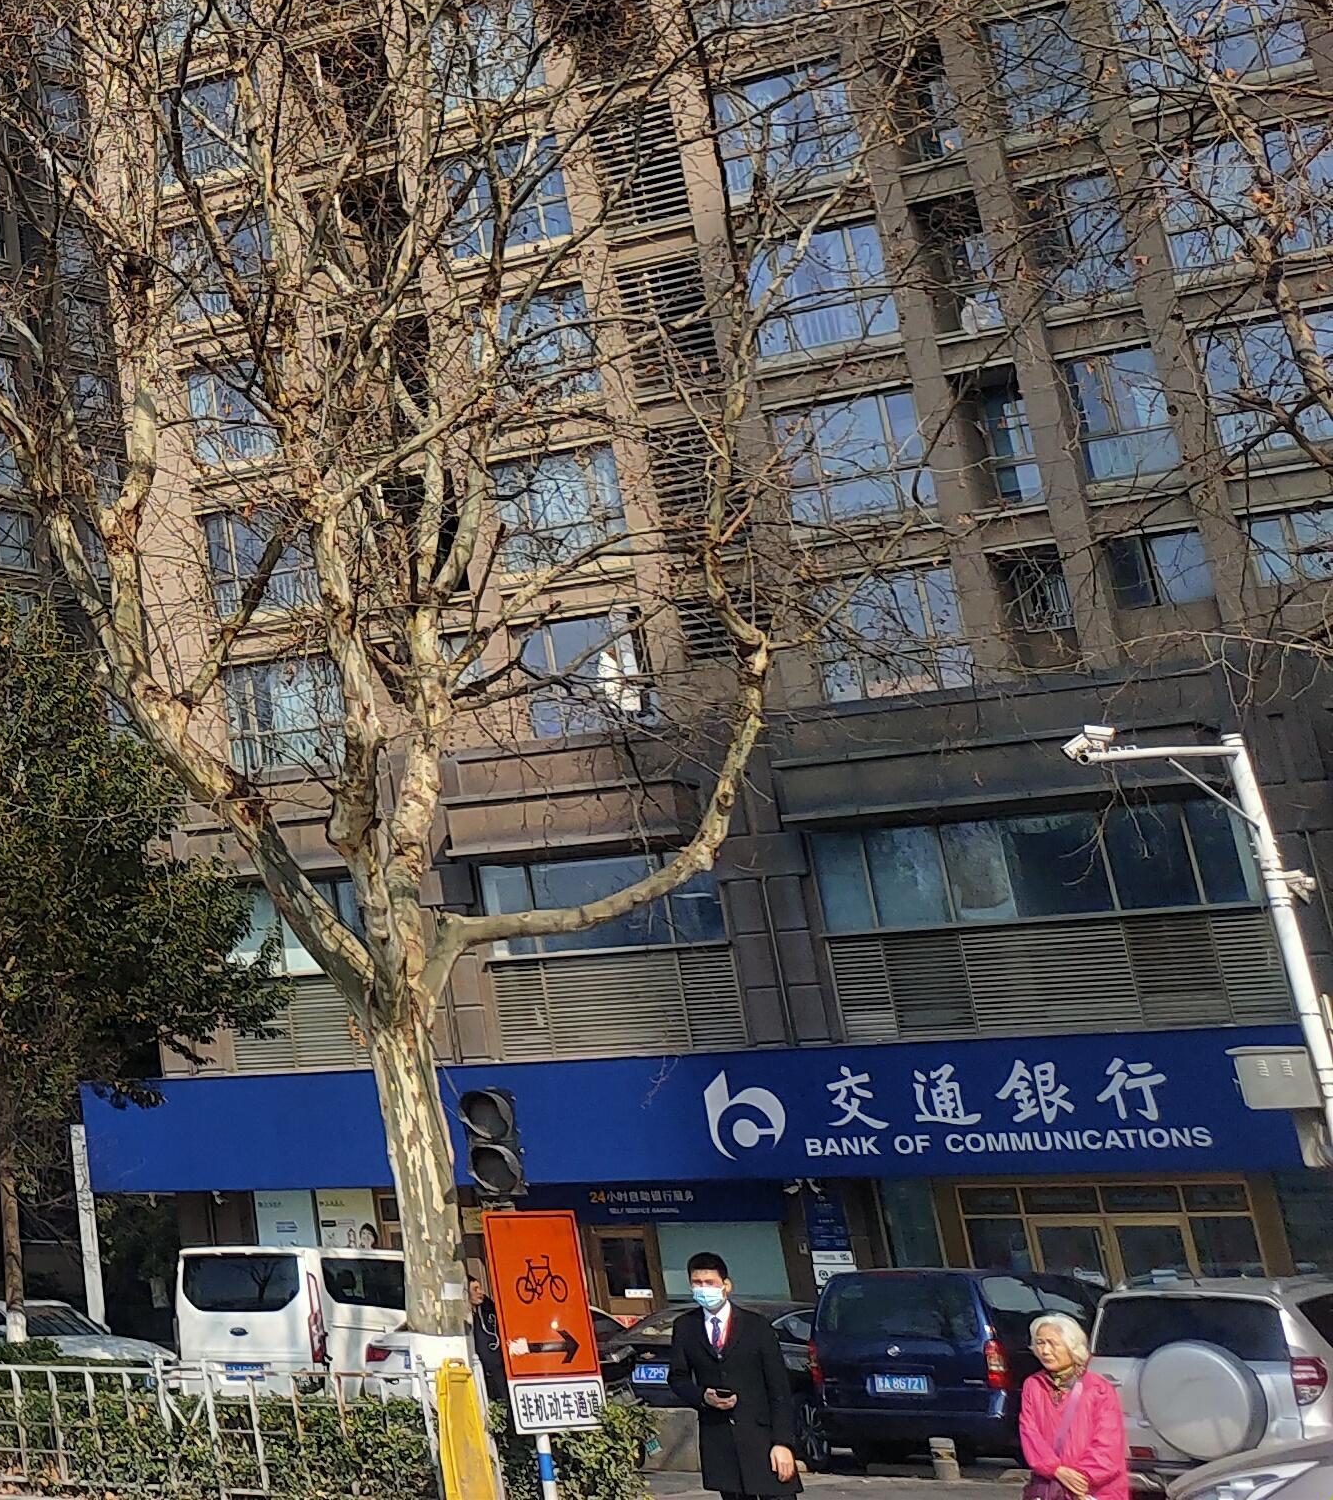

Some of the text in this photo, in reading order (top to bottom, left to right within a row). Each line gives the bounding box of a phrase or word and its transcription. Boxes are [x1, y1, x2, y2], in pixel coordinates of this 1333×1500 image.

[827, 1057, 1166, 1130] 交通銀行
[805, 1126, 1213, 1157] BANK OF COMMUNICATIONS
[520, 1389, 604, 1423] 非机动车通道
